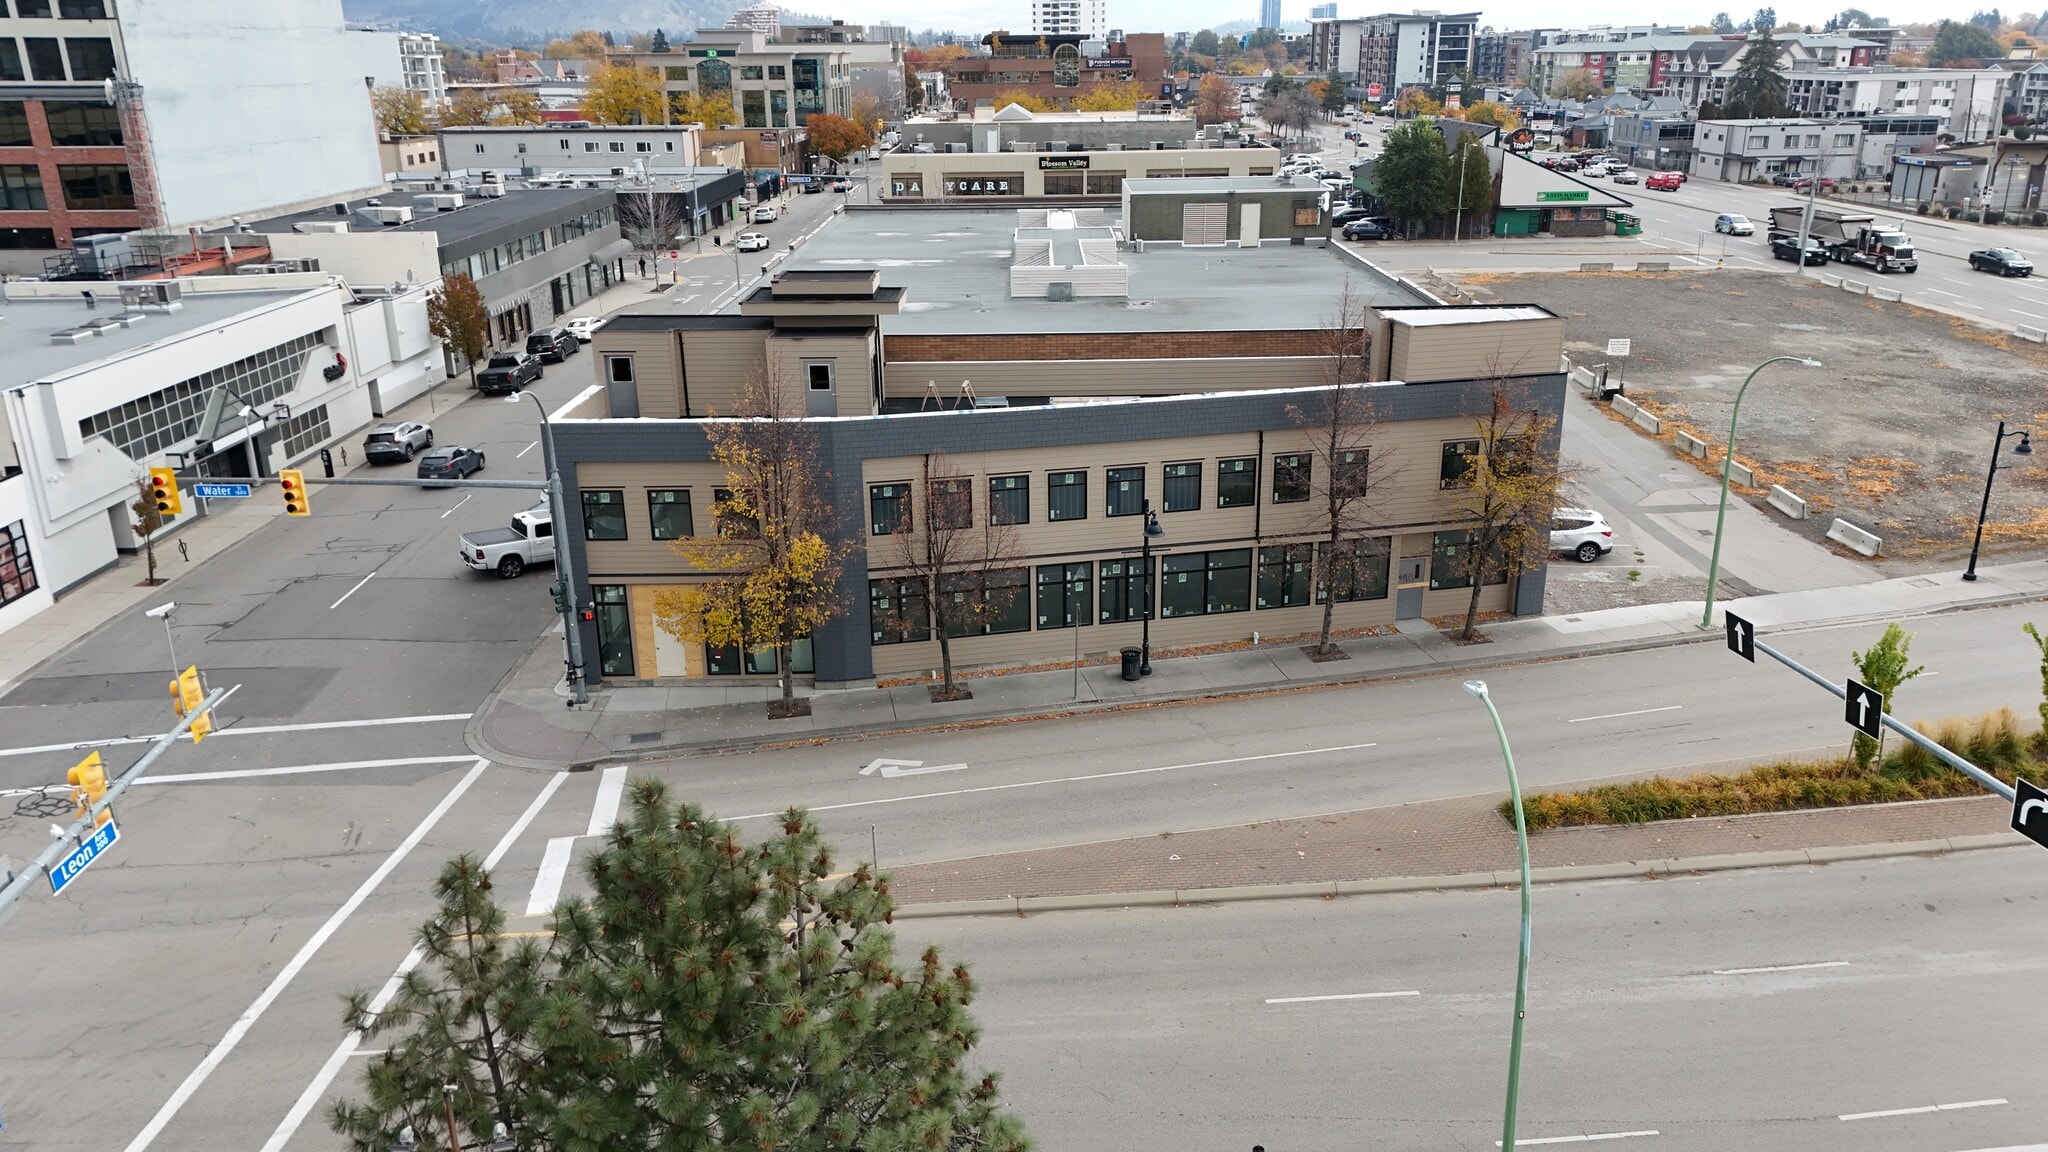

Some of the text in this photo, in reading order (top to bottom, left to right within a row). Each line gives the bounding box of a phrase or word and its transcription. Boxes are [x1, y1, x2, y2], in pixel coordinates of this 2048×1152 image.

[1041, 160, 1088, 168] Blossom Valley
[202, 486, 231, 496] Water
[96, 836, 109, 852] 200
[61, 830, 106, 880] Leon Ave
